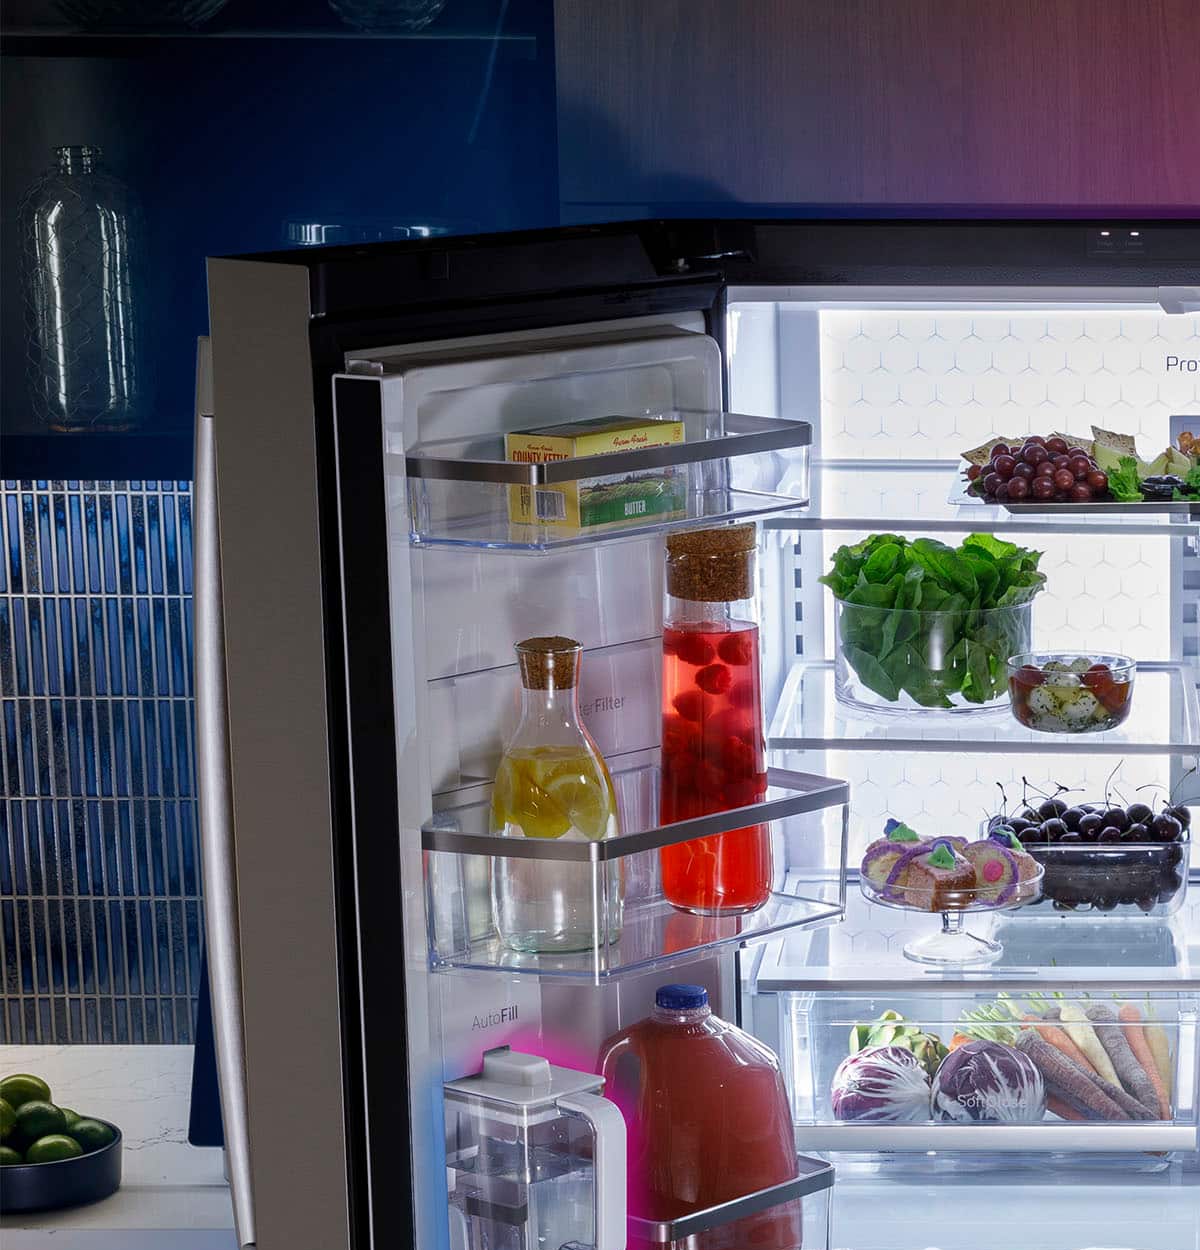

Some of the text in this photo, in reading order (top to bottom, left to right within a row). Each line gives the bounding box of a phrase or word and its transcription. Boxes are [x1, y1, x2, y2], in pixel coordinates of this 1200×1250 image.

[624, 500, 646, 516] BUTTER
[578, 696, 625, 716] terFilter
[471, 1004, 518, 1031] AutoFill
